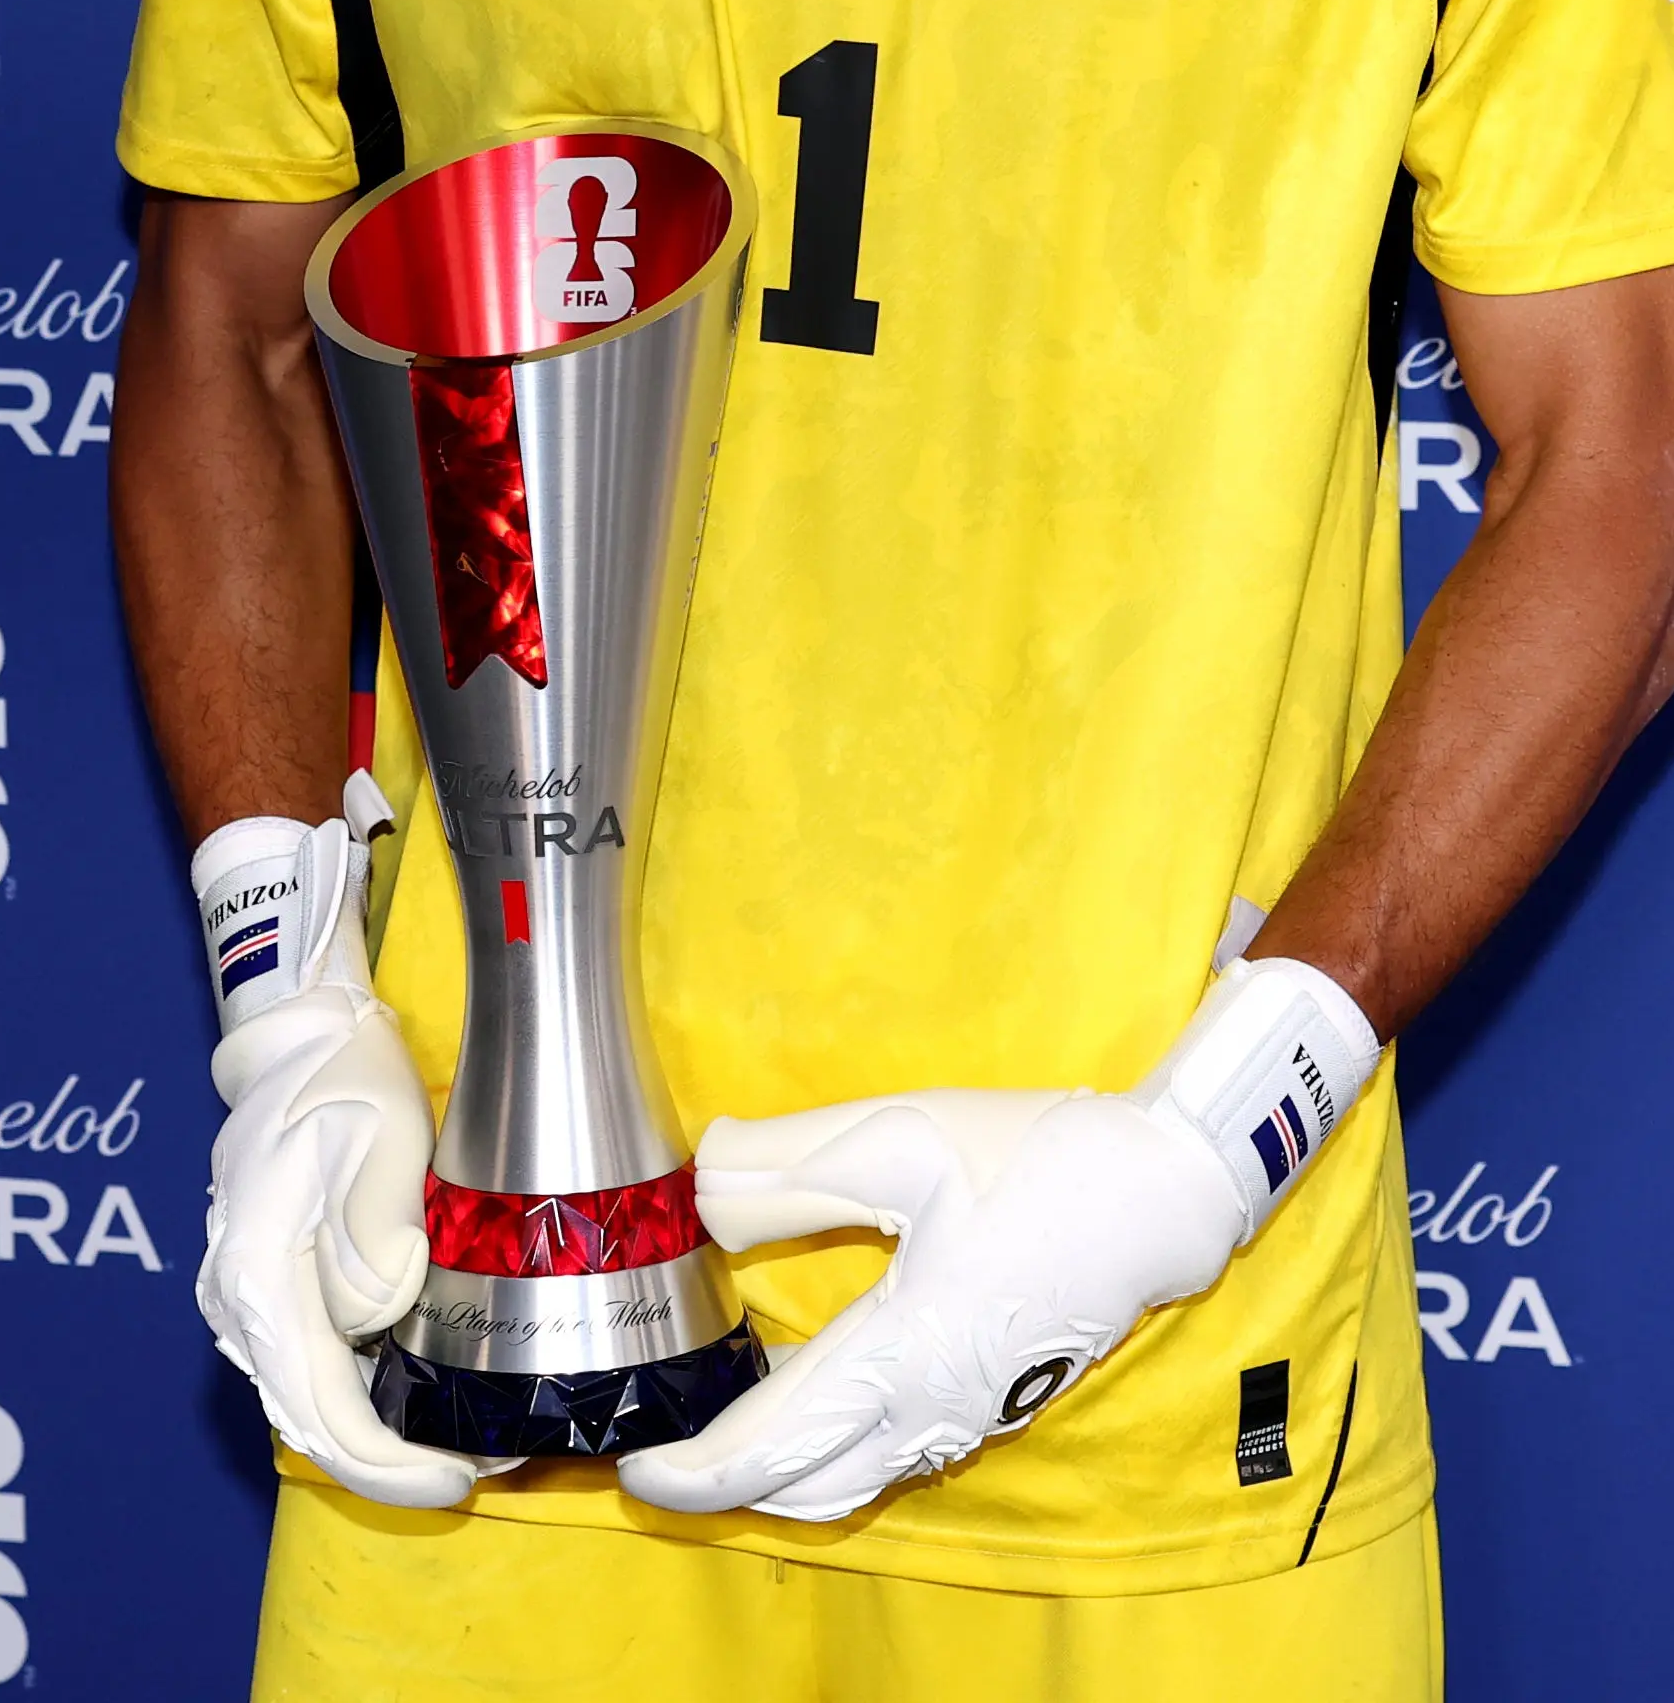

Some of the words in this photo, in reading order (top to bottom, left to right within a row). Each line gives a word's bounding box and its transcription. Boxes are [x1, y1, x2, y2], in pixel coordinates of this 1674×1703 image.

[760, 39, 881, 357] 1
[562, 289, 609, 308] FIFA
[206, 875, 302, 935] VOZINHA
[1292, 1042, 1335, 1144] OZINHA
[441, 1300, 519, 1342] Player
[507, 1315, 549, 1347] of
[594, 1295, 673, 1333] Match
[1238, 1431, 1284, 1450] LICENSED
[1240, 1422, 1285, 1440] AUTHENTIC
[1237, 1441, 1284, 1459] PRODUCT
